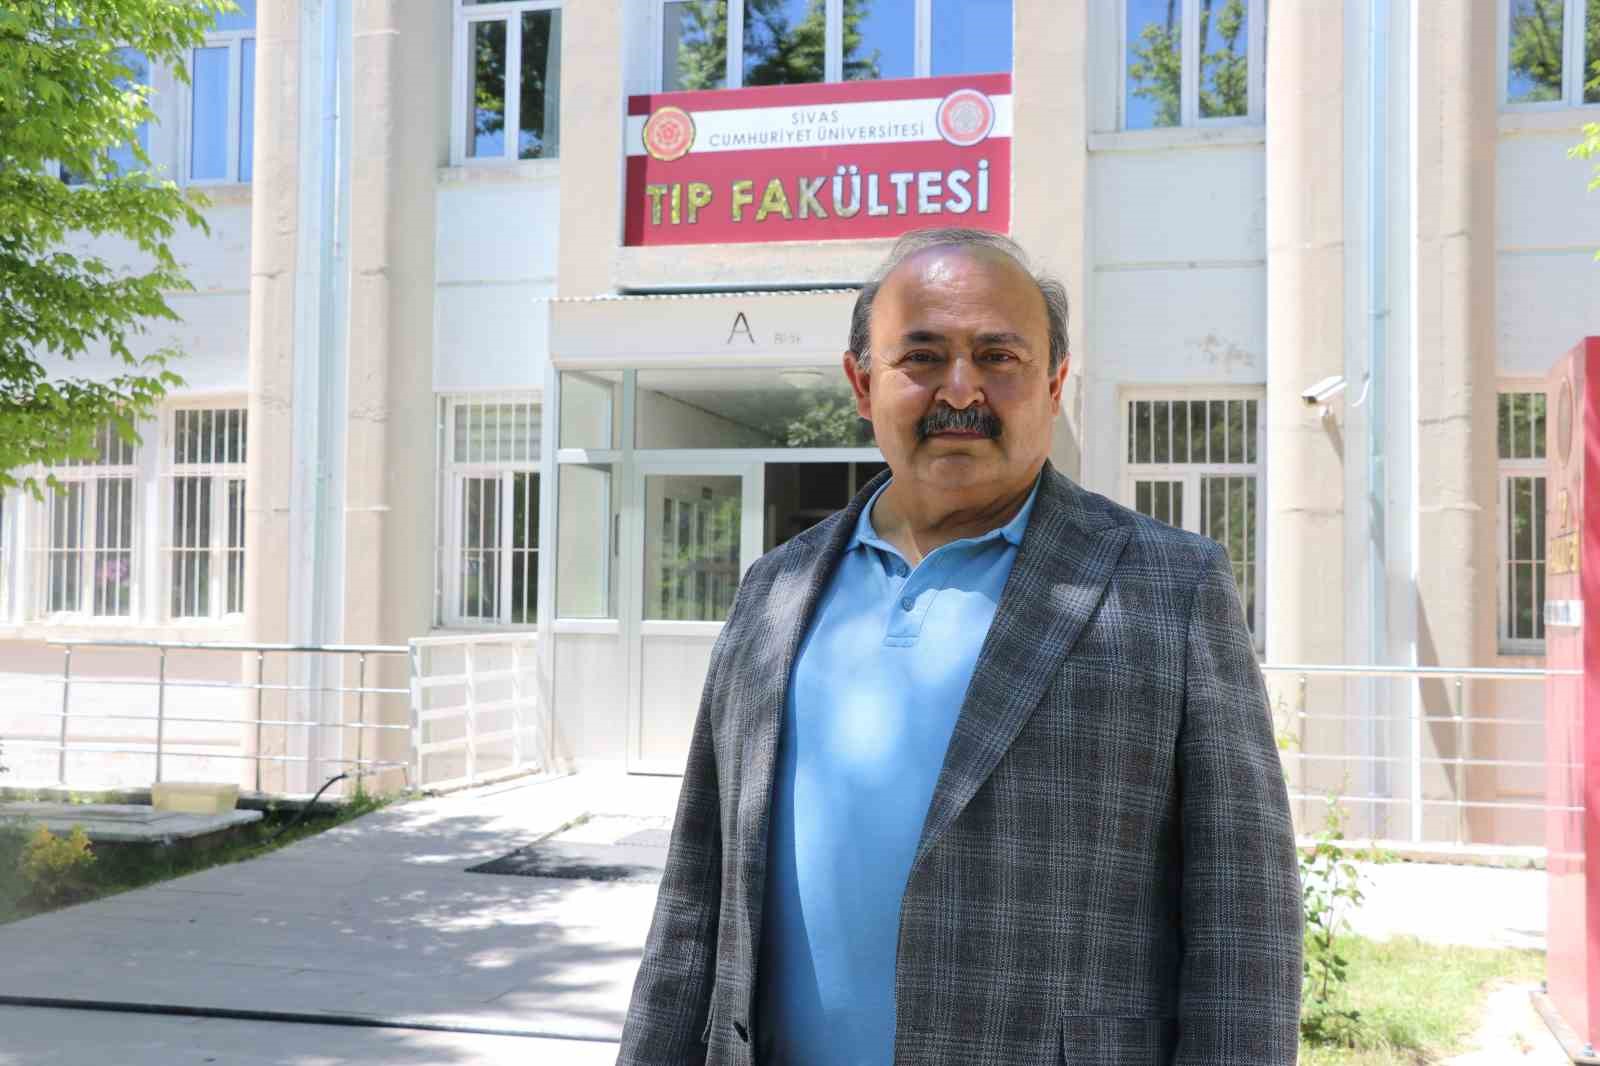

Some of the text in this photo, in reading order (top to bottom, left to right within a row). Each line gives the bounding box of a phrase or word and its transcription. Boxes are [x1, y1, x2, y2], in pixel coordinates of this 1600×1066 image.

[709, 119, 925, 147] CUMHURİYET ÜNİVERSİTESİ
[646, 159, 990, 225] TIP FAKÜLTESİ
[727, 311, 755, 344] A
